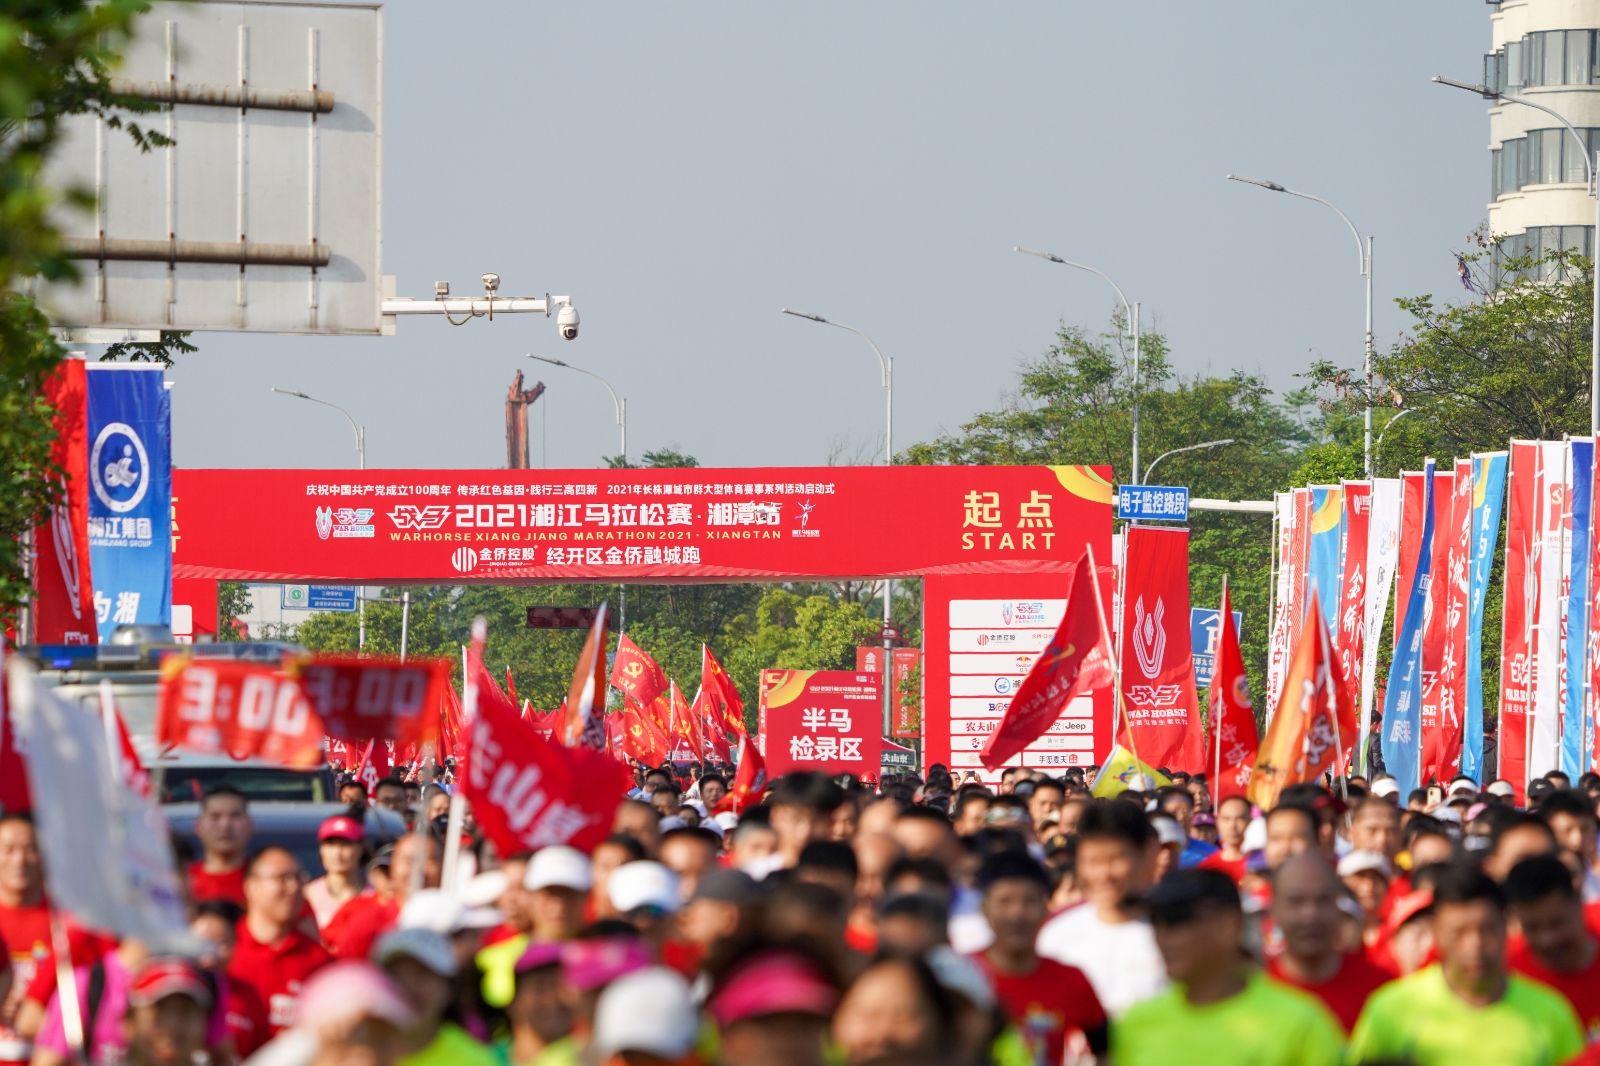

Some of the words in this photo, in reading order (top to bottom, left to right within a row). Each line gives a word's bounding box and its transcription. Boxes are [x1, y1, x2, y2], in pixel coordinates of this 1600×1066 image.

[306, 484, 451, 497] 庆祝中国共产党成立100周年
[962, 489, 1054, 529] 起点
[1120, 490, 1187, 516] 电子监控路段
[390, 532, 471, 542] WARHORSE
[475, 532, 521, 542] XIANG
[524, 532, 568, 542] JIANG
[574, 531, 656, 541] MARATHON
[706, 530, 782, 540] XIANGTAN
[961, 531, 1056, 550] START
[479, 546, 536, 561] 金侨控股
[546, 545, 701, 565] 经开区金侨融城跑
[801, 707, 852, 733] 半马
[1151, 708, 1188, 719] HORSE
[965, 721, 1002, 732] 农夫山
[1065, 721, 1086, 731] Jeep
[789, 735, 863, 761] 检录区
[880, 753, 908, 763] 夫山泉
